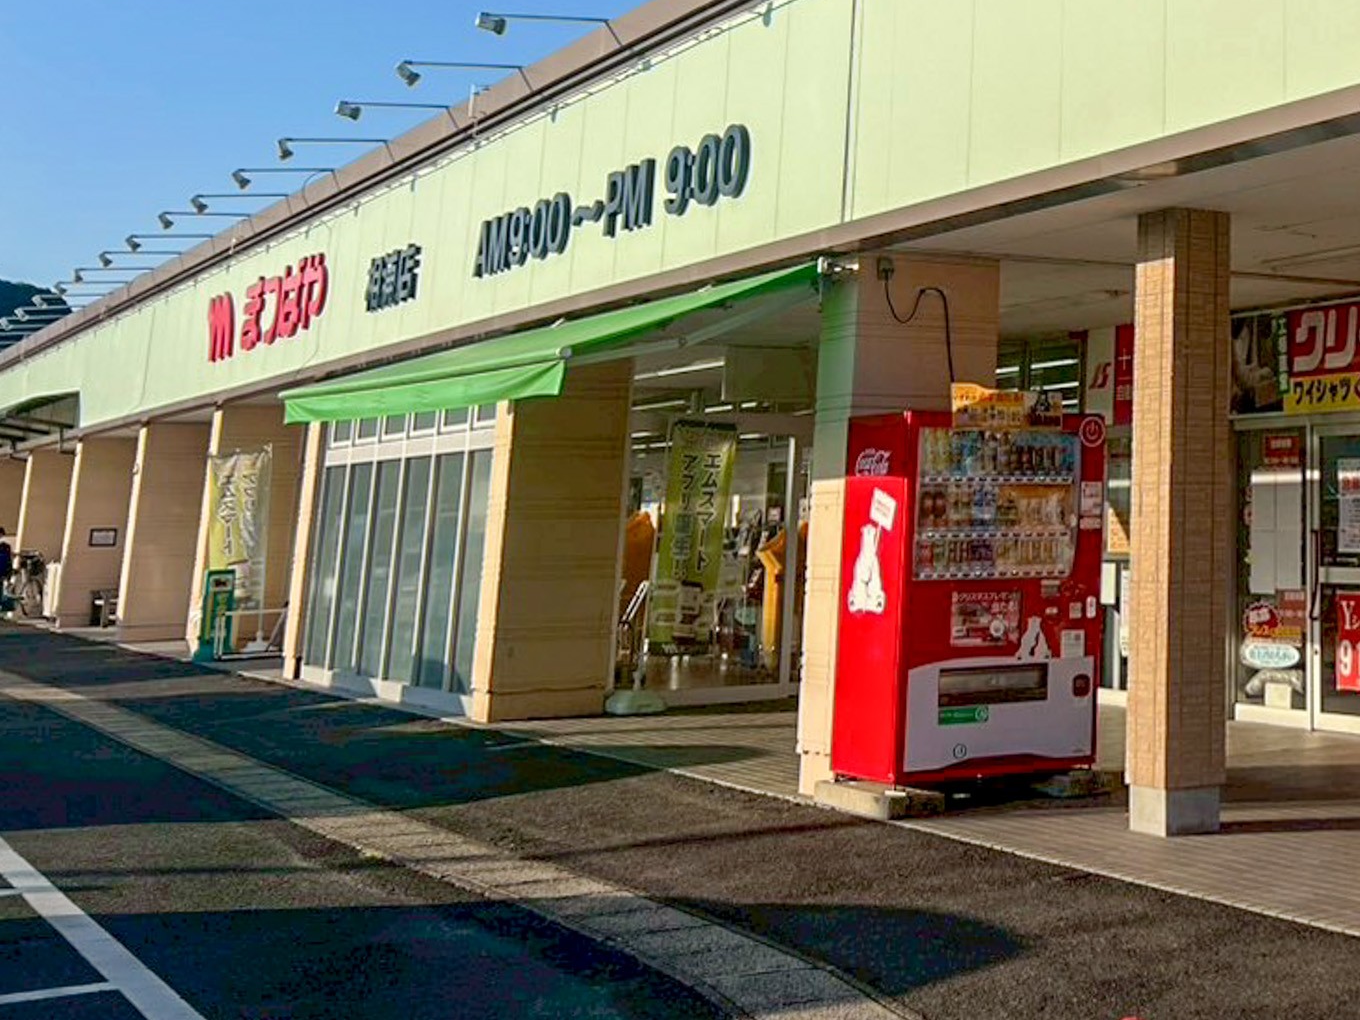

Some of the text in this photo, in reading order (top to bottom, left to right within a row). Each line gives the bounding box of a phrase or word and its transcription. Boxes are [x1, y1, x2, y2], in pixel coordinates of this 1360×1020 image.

[664, 124, 750, 217] 9:00
[240, 252, 329, 351] まつばや
[1294, 379, 1351, 405] ワイシャツ
[696, 453, 722, 571] エムスマート
